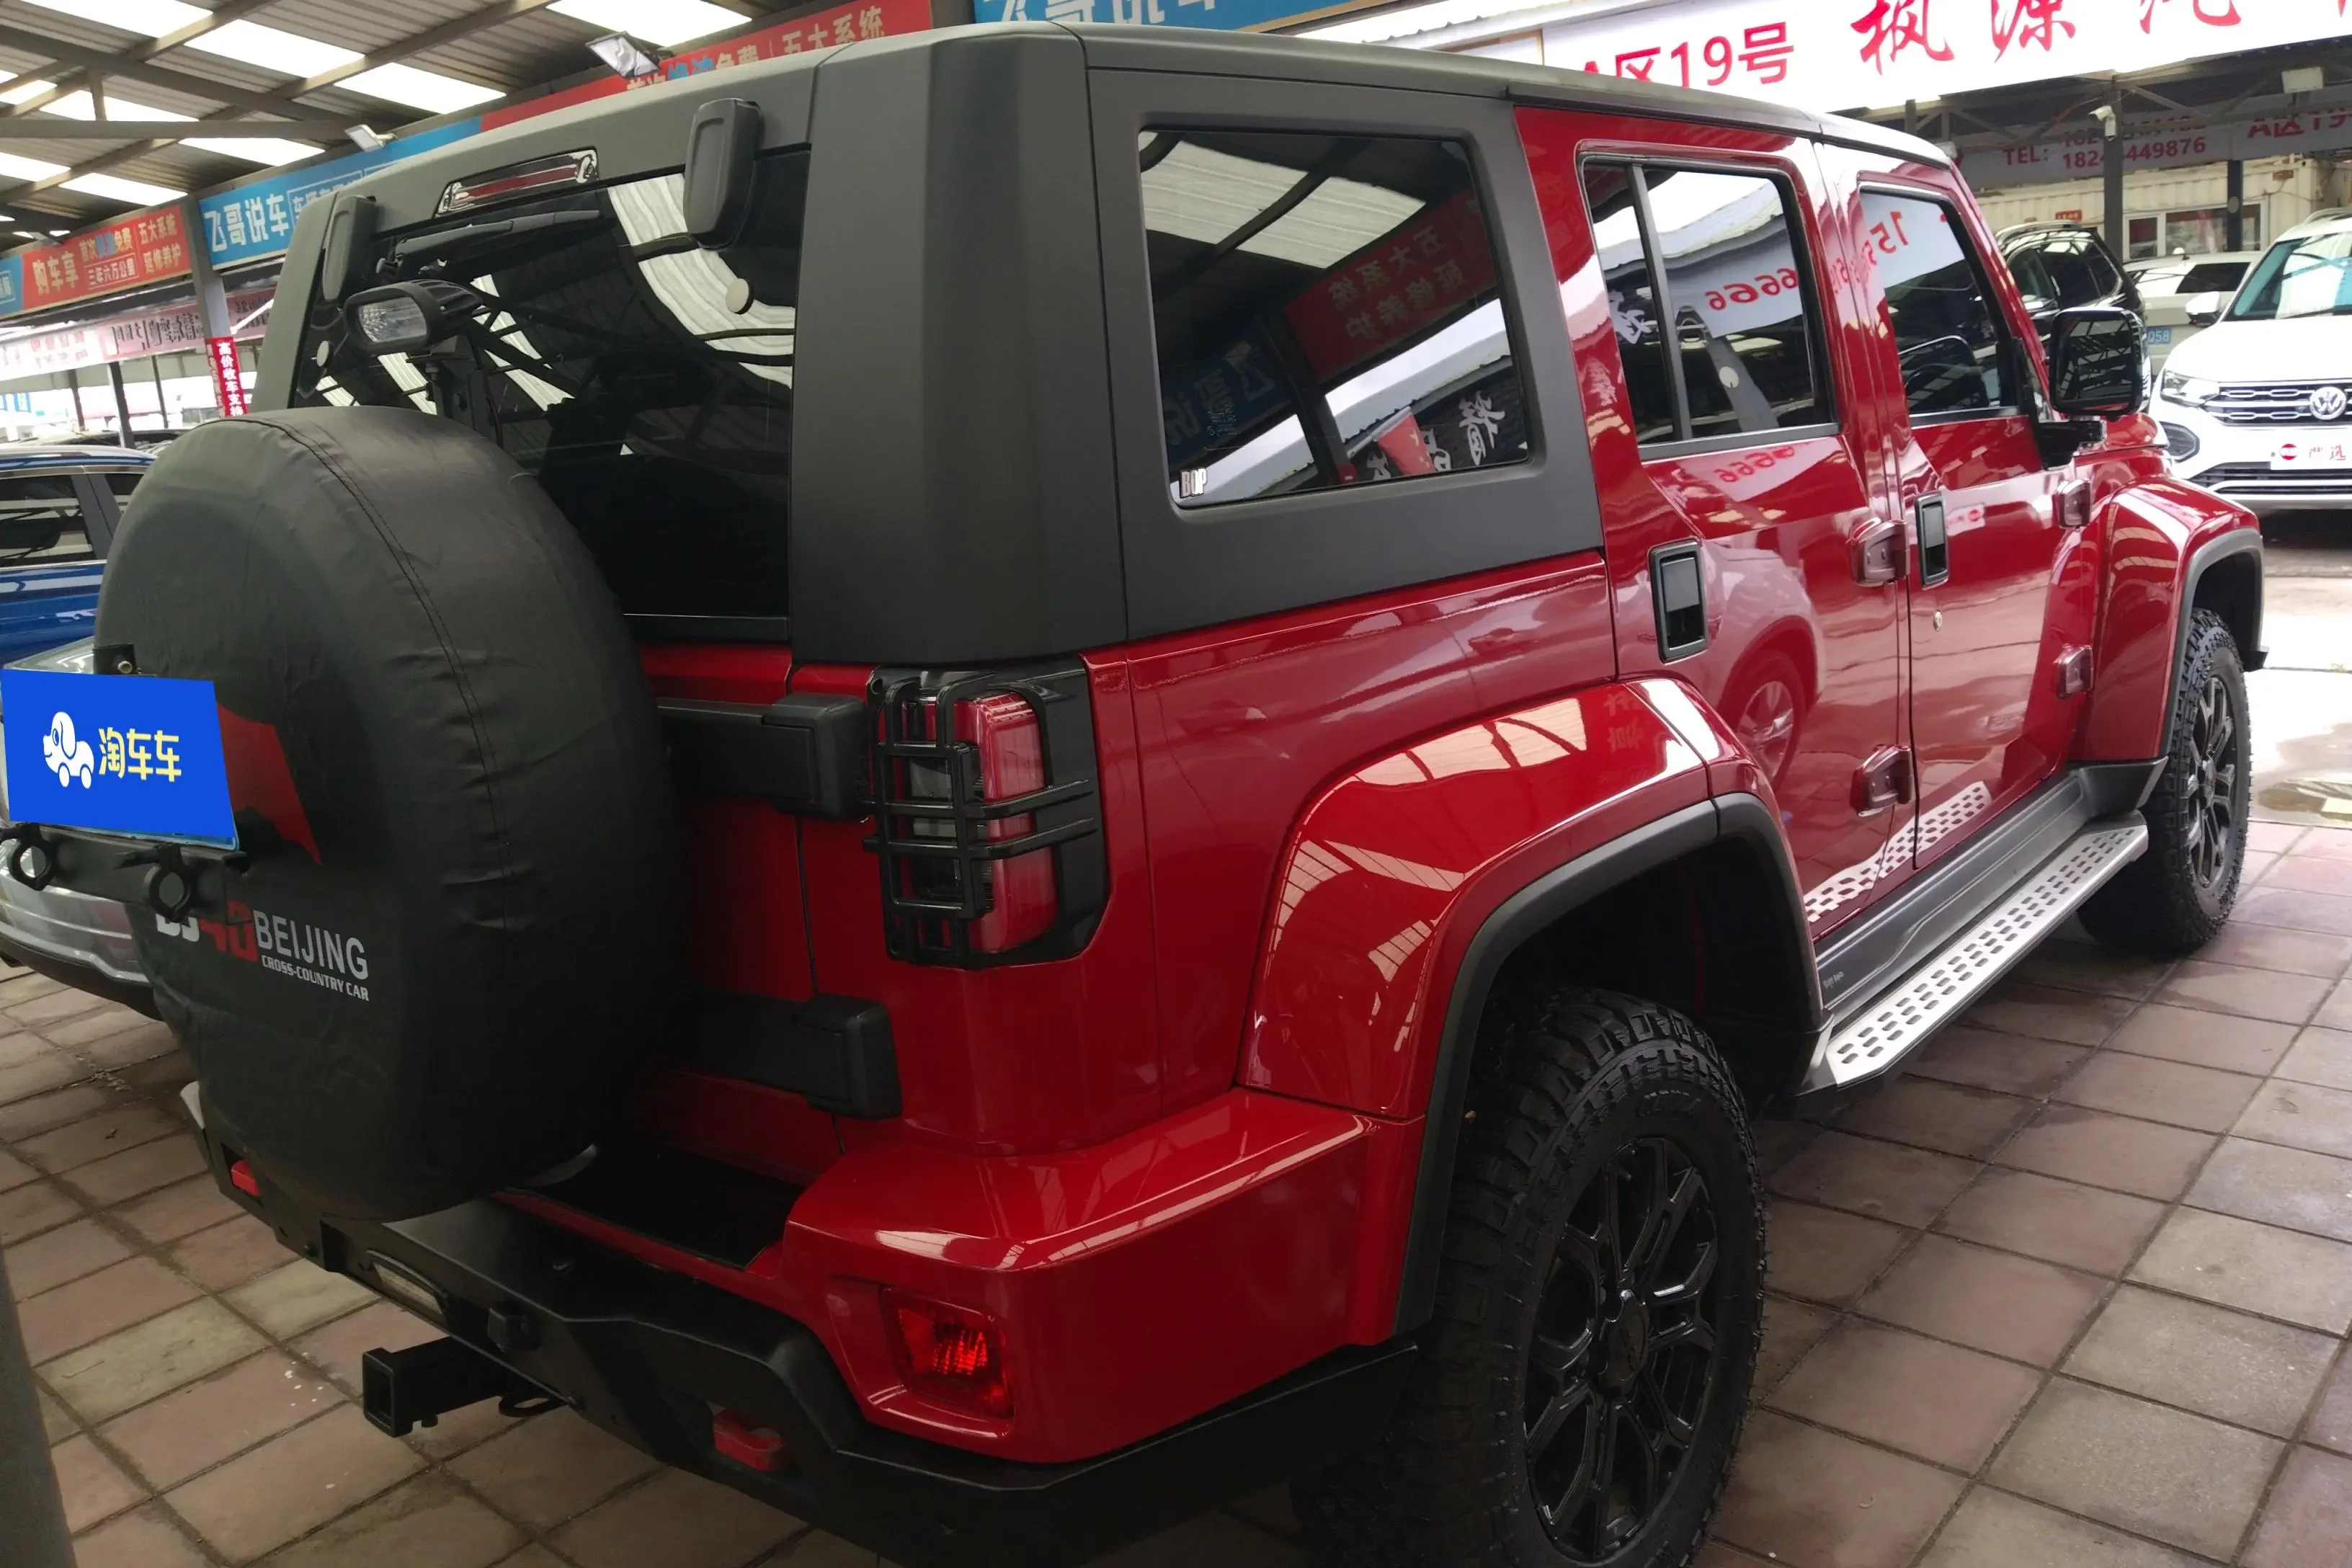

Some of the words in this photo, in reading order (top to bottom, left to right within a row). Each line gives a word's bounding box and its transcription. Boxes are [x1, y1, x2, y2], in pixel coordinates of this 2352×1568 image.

[1582, 21, 1795, 89] 区19号
[2062, 136, 2206, 169] 182449876
[137, 213, 178, 245] 五大系统
[204, 194, 290, 253] 飞哥说车
[32, 251, 79, 295] 购车享
[143, 242, 182, 274] 延修养护
[253, 909, 369, 981] BEIJING
[262, 954, 346, 993] CROSS-COUNTRY
[345, 981, 370, 1002] CAR
